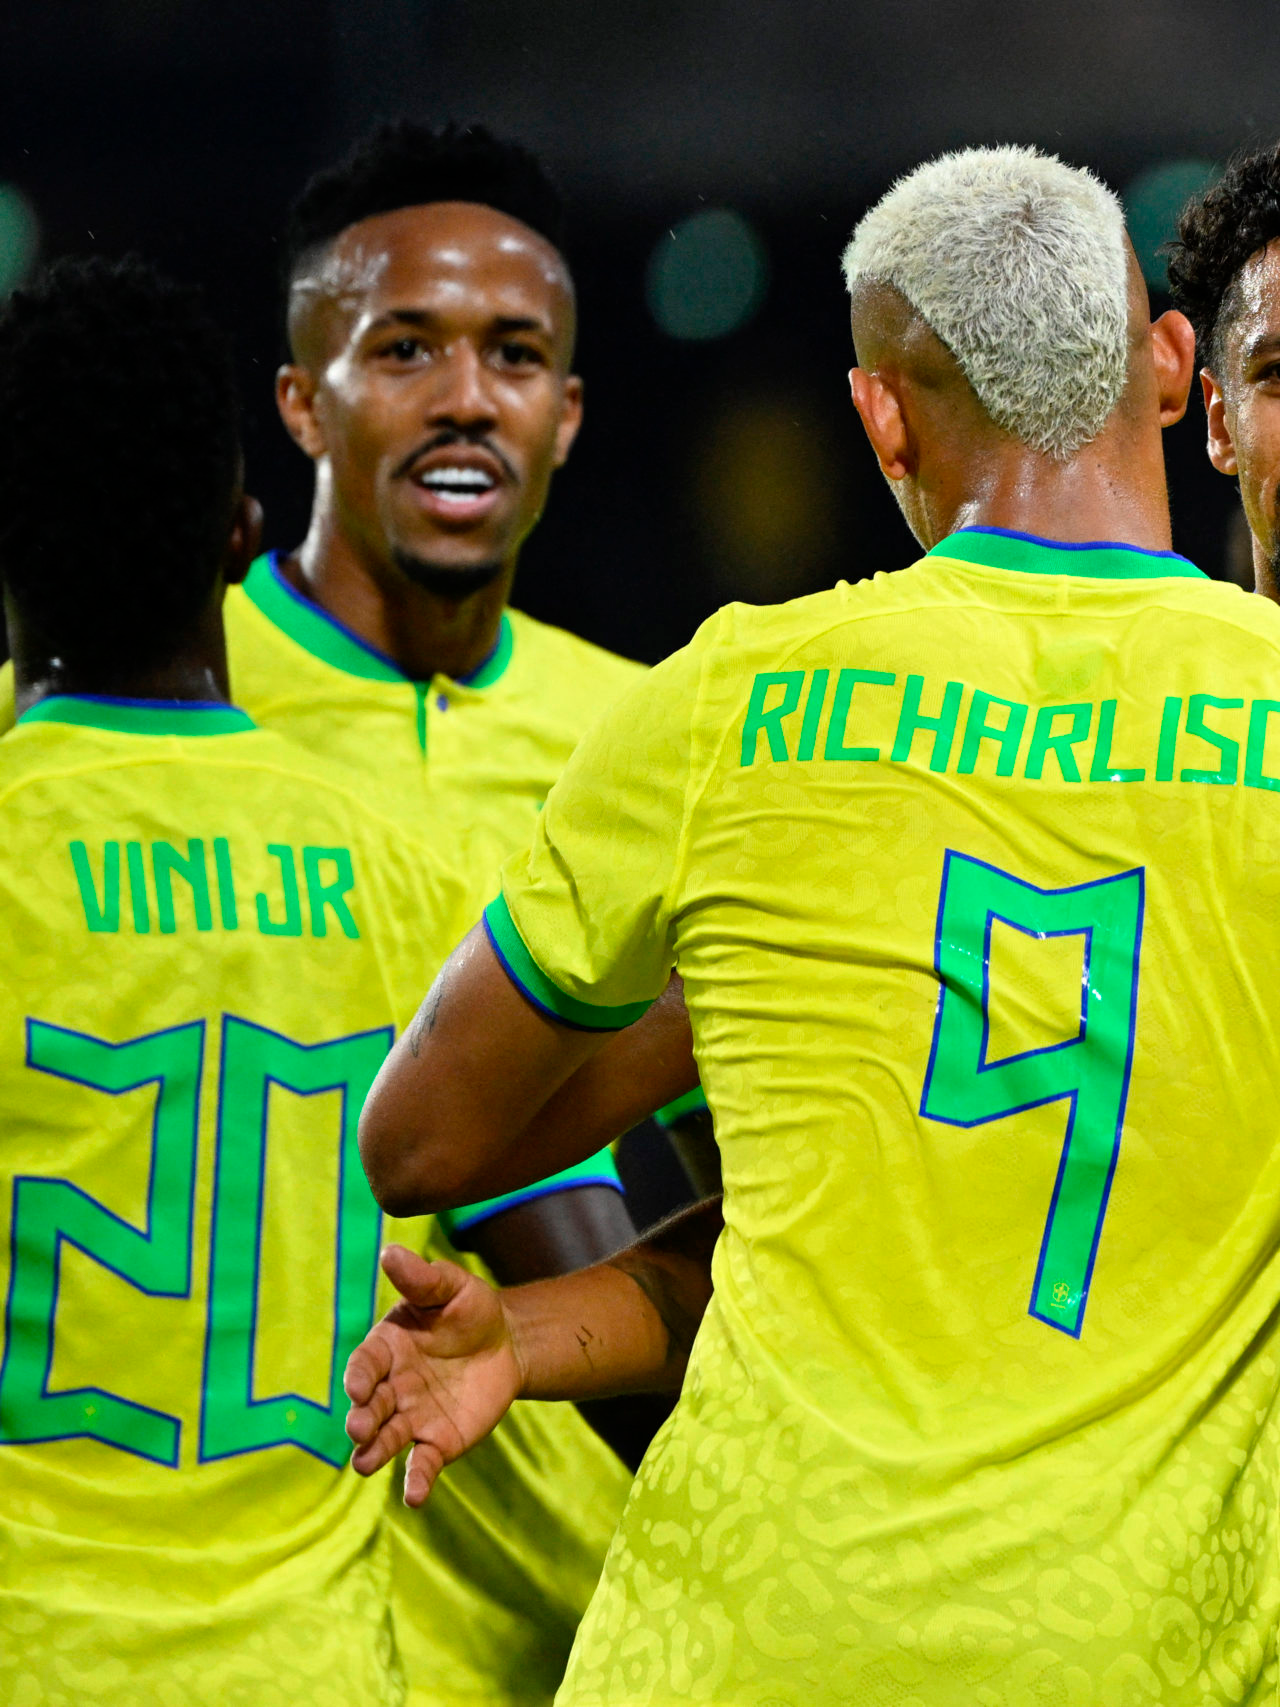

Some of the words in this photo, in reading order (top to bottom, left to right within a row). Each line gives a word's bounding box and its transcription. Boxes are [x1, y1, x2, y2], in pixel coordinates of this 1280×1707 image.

[69, 837, 239, 934] VINI
[255, 843, 361, 939] JR
[918, 847, 1146, 1341] 9
[0, 1012, 396, 1470] 20
